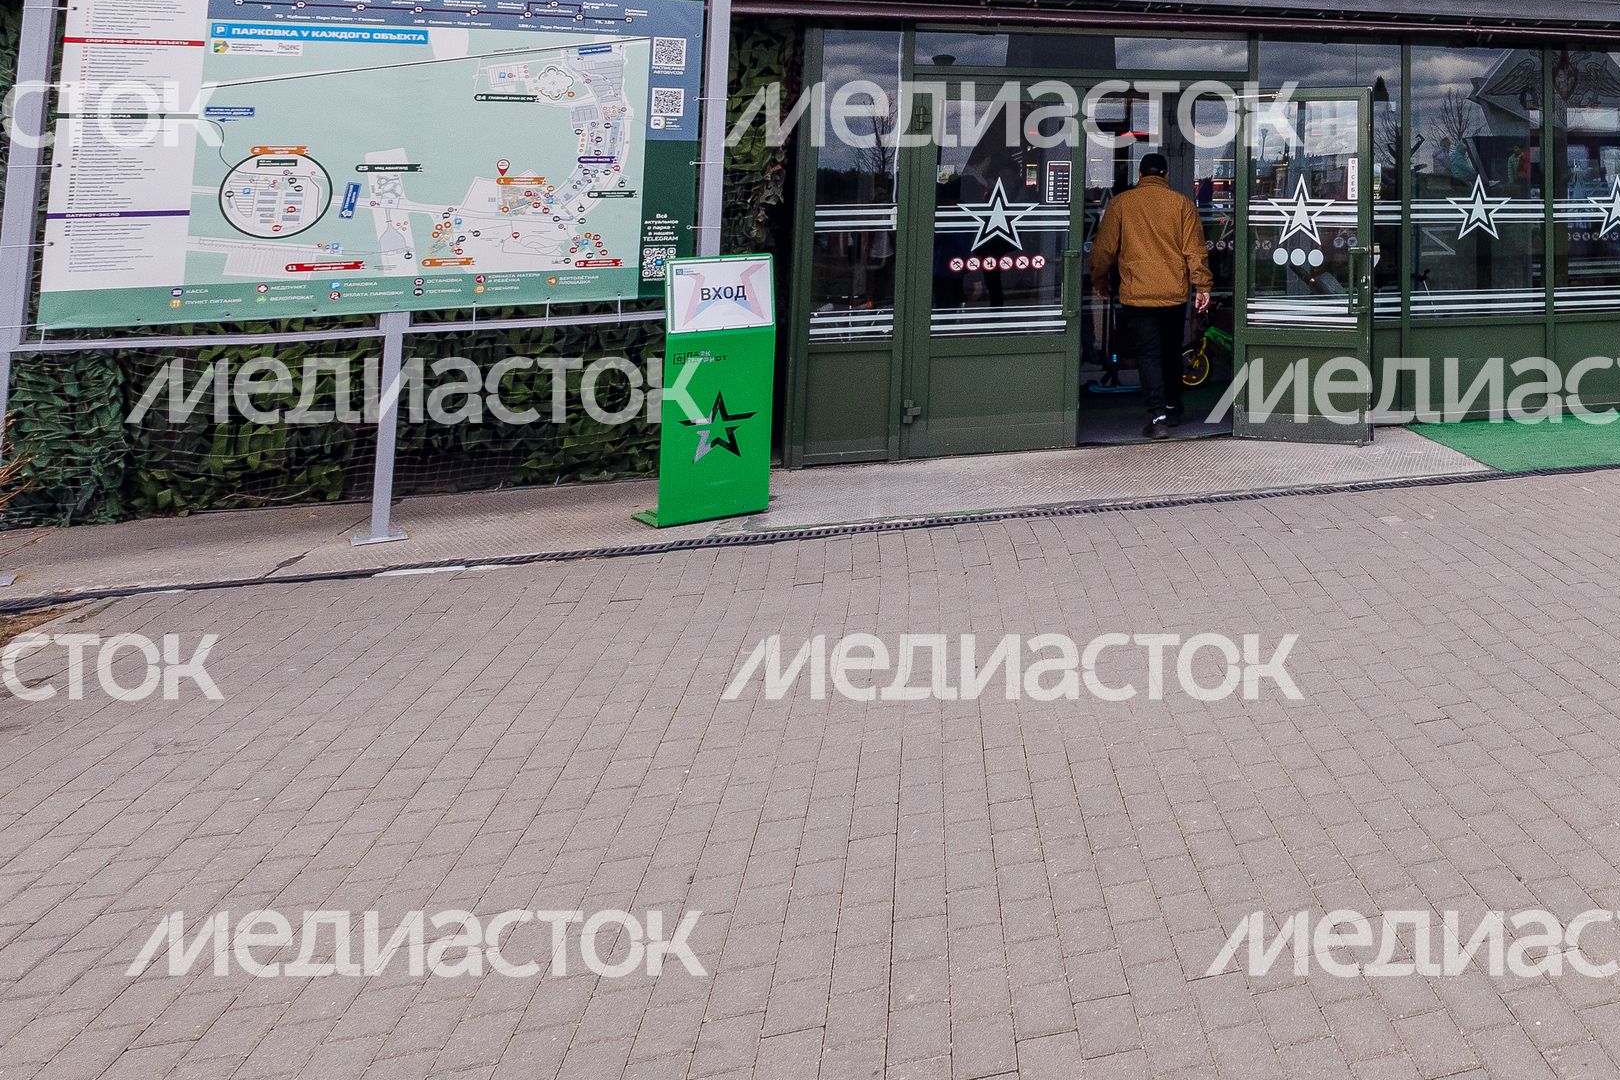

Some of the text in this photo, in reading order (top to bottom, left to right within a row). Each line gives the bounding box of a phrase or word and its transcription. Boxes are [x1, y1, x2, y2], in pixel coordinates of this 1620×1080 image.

[232, 27, 425, 41] ПАРКОВКА У КАЖДОГО ОБЪЕКТА
[701, 285, 747, 301] ВХОД
